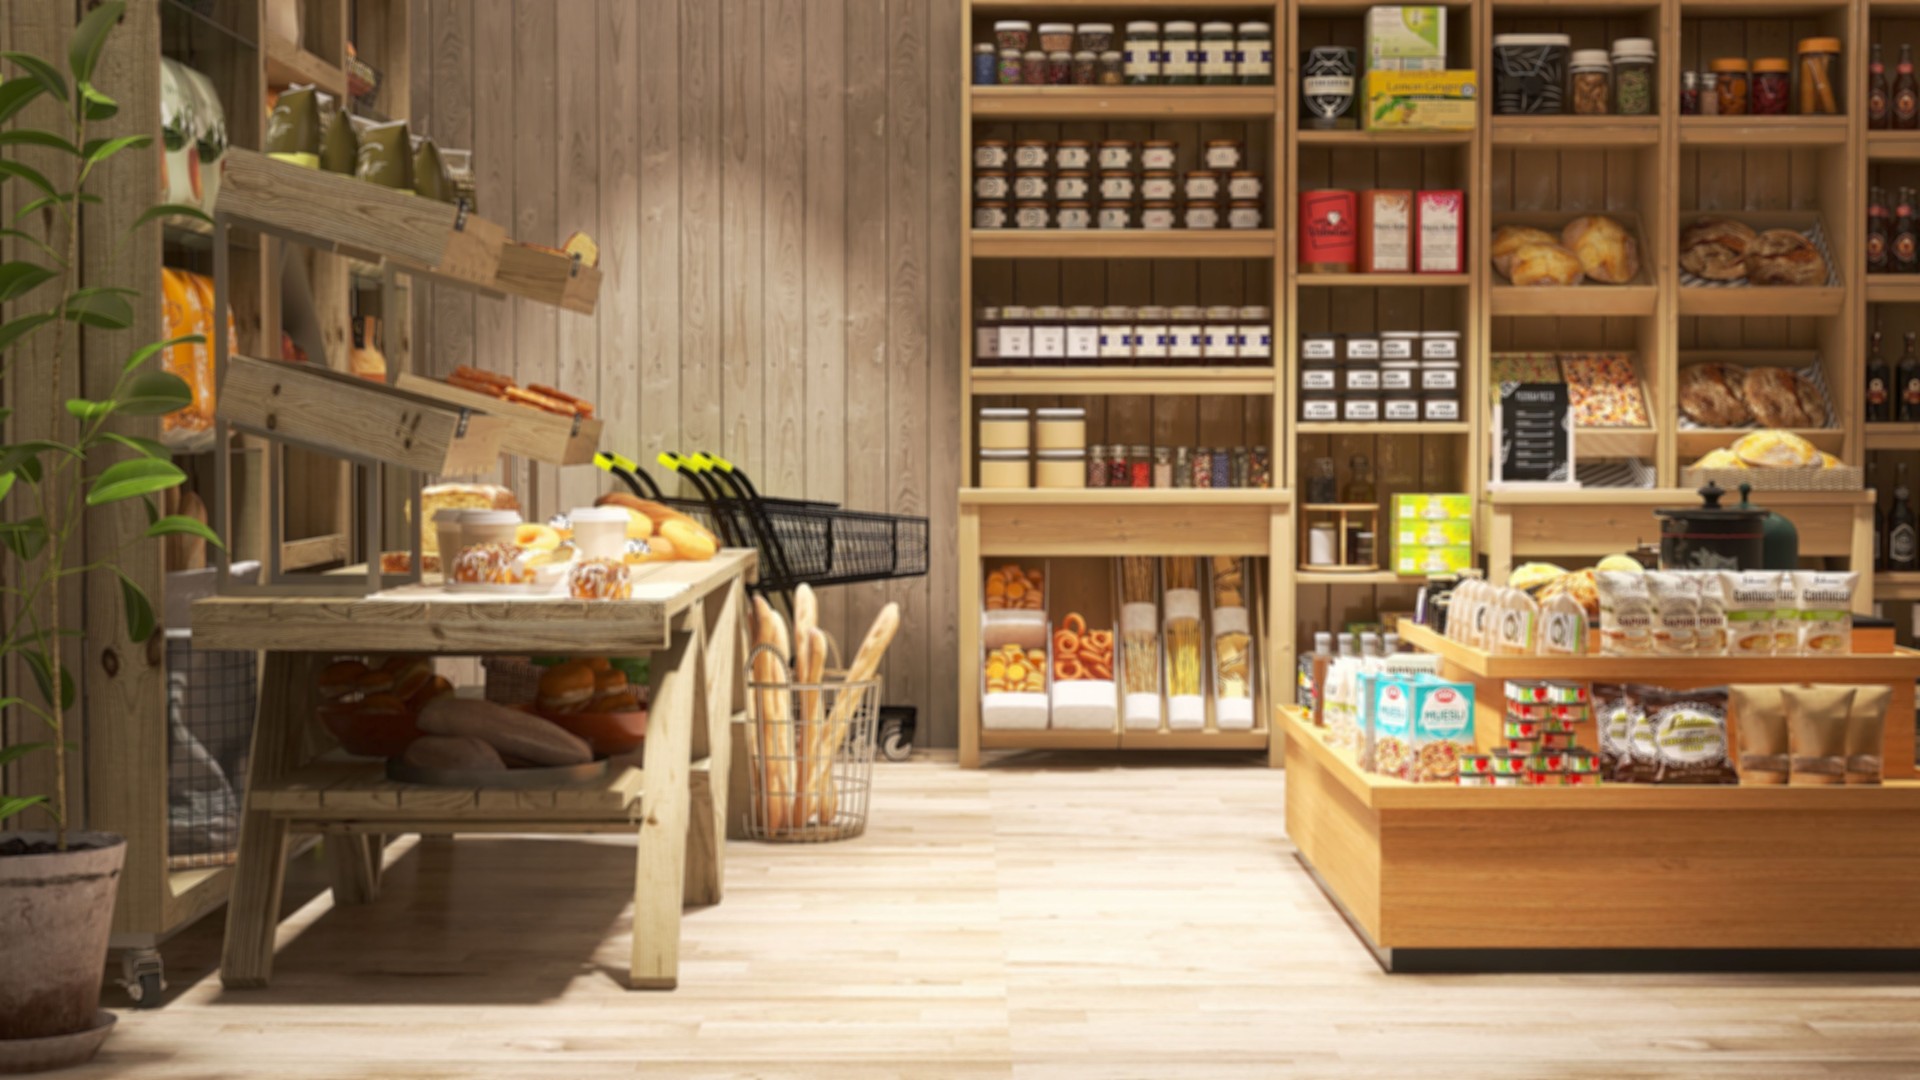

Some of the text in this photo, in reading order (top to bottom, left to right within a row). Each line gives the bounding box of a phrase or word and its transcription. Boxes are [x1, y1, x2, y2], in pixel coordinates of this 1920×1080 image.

[1386, 80, 1459, 93] Lemon Ginger
[1424, 708, 1465, 721] MUESLI
